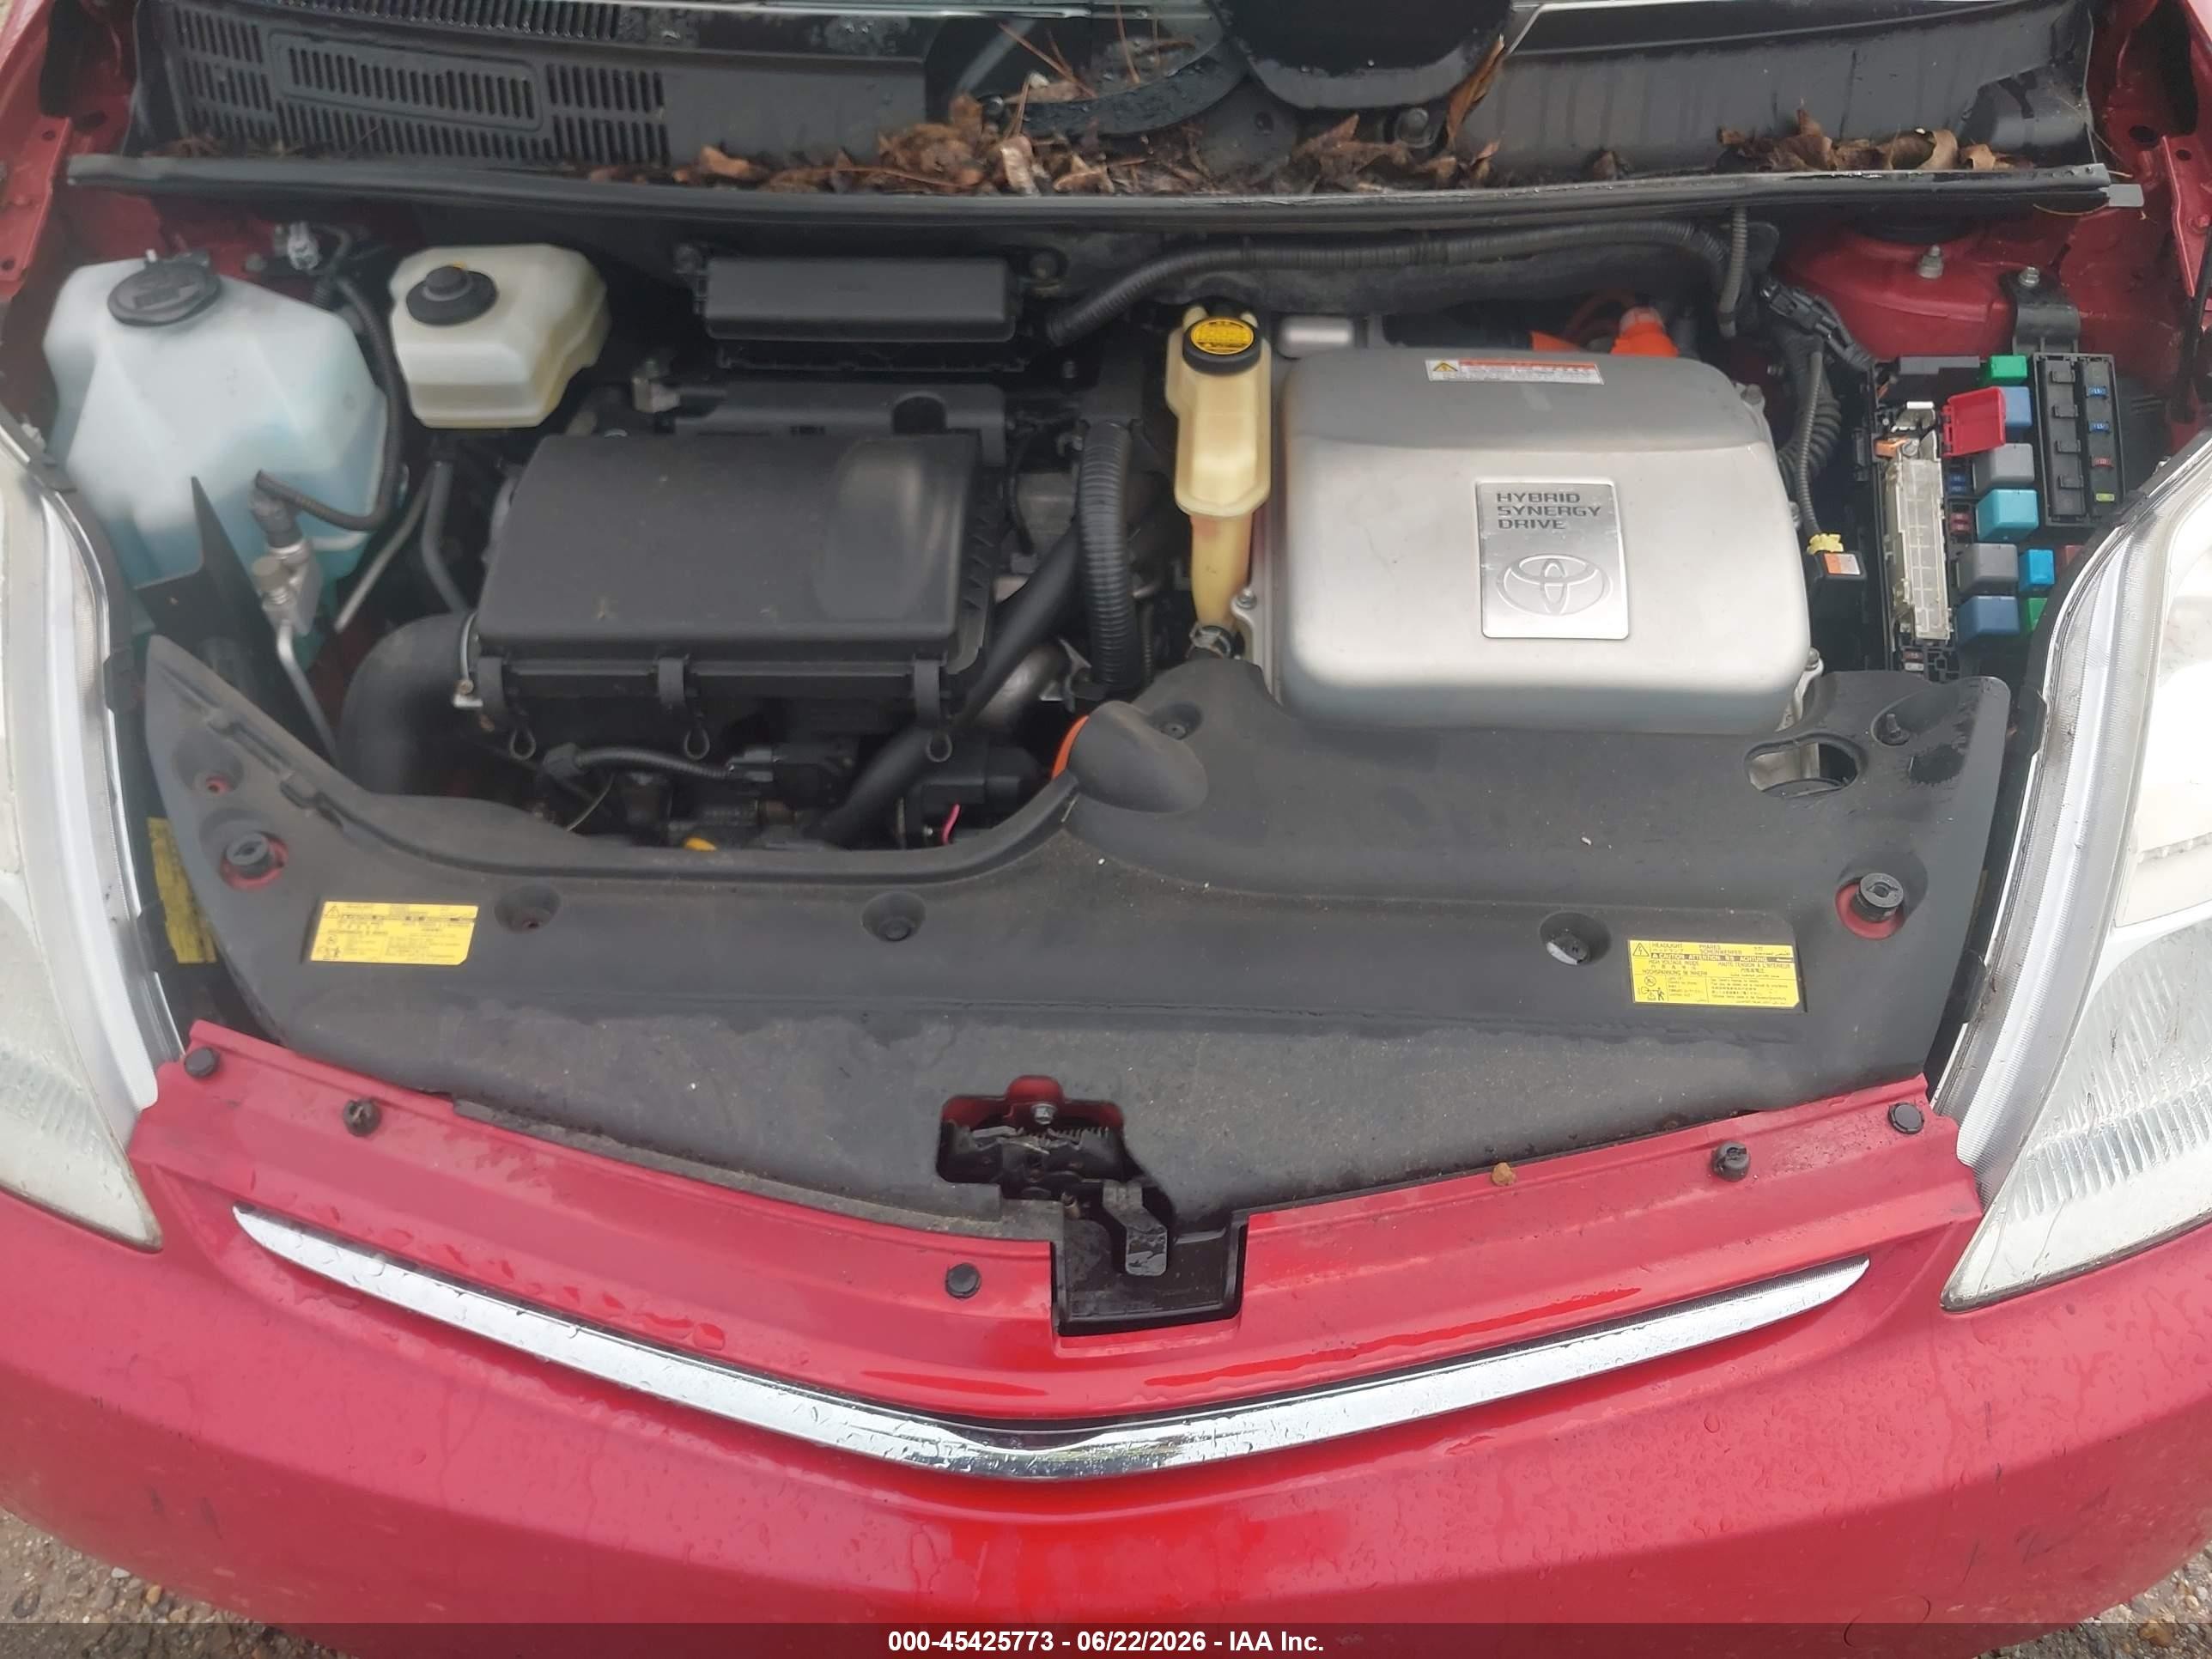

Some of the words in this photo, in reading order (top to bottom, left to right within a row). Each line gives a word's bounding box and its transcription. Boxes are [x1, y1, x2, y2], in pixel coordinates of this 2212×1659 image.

[1497, 493, 1580, 503] HYBRID
[1497, 506, 1601, 517] SYNERGY
[1498, 519, 1565, 530] DRIVE
